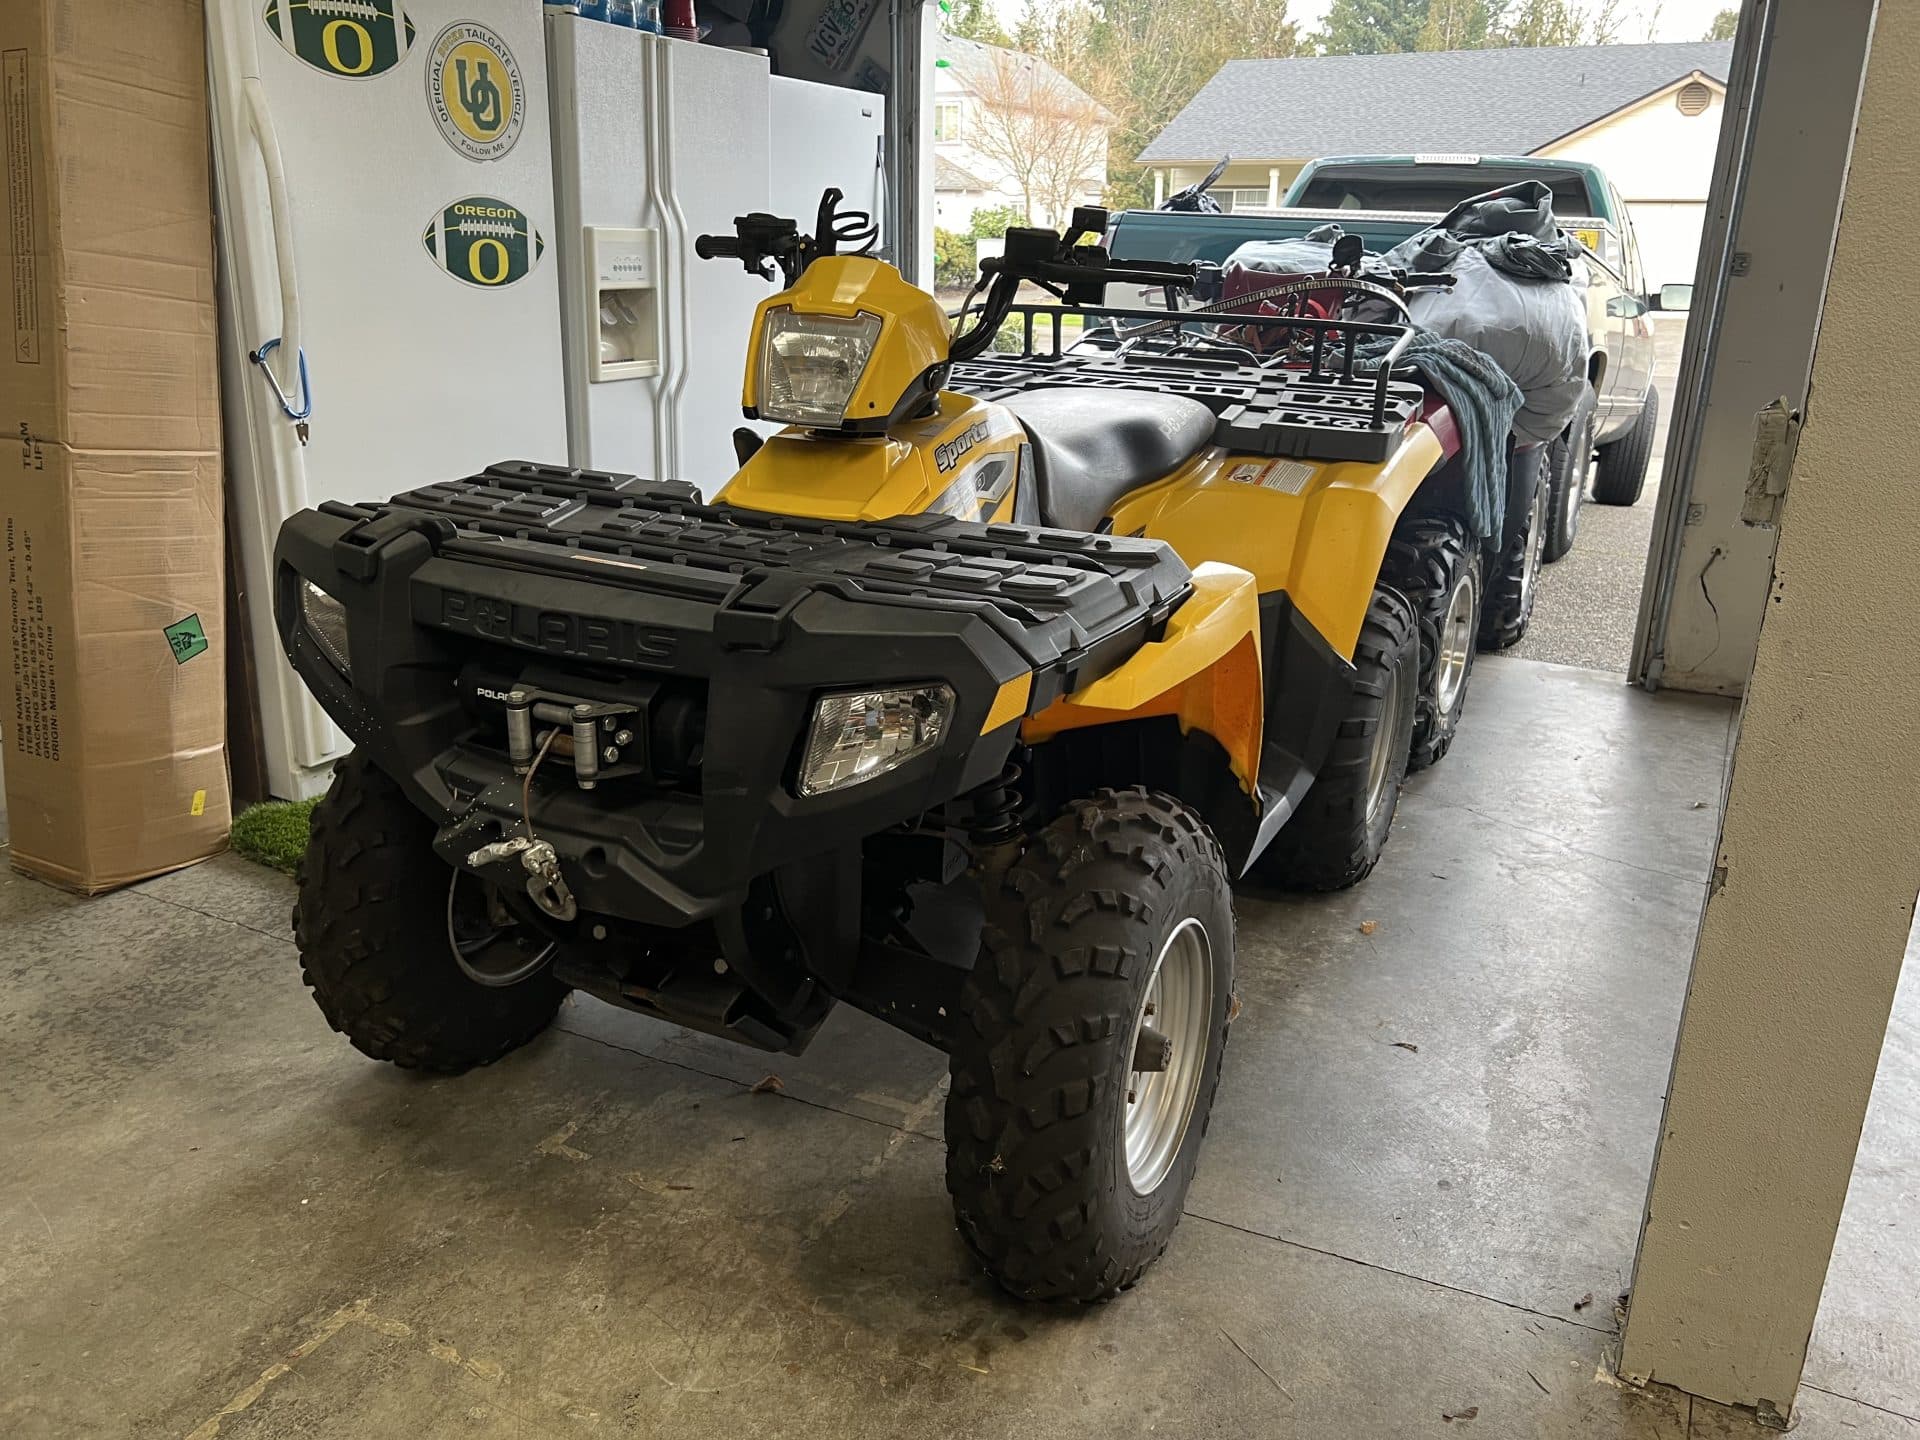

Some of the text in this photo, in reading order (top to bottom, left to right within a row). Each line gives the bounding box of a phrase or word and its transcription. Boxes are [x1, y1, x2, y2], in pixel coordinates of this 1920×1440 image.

[322, 20, 374, 74] O
[431, 60, 449, 123] OFFICIAL
[464, 28, 512, 67] TAILGATE
[510, 69, 522, 128] VEHICLE
[453, 203, 518, 220] OREGON
[468, 238, 510, 285] O
[19, 421, 32, 470] TEAM
[32, 434, 44, 471] LIFT
[46, 626, 54, 661] China
[440, 587, 679, 669] POLARIS
[25, 726, 33, 754] ITEM
[33, 702, 42, 757] PACKING
[42, 716, 50, 759] GROSS
[51, 714, 59, 761] ORIGIN:
